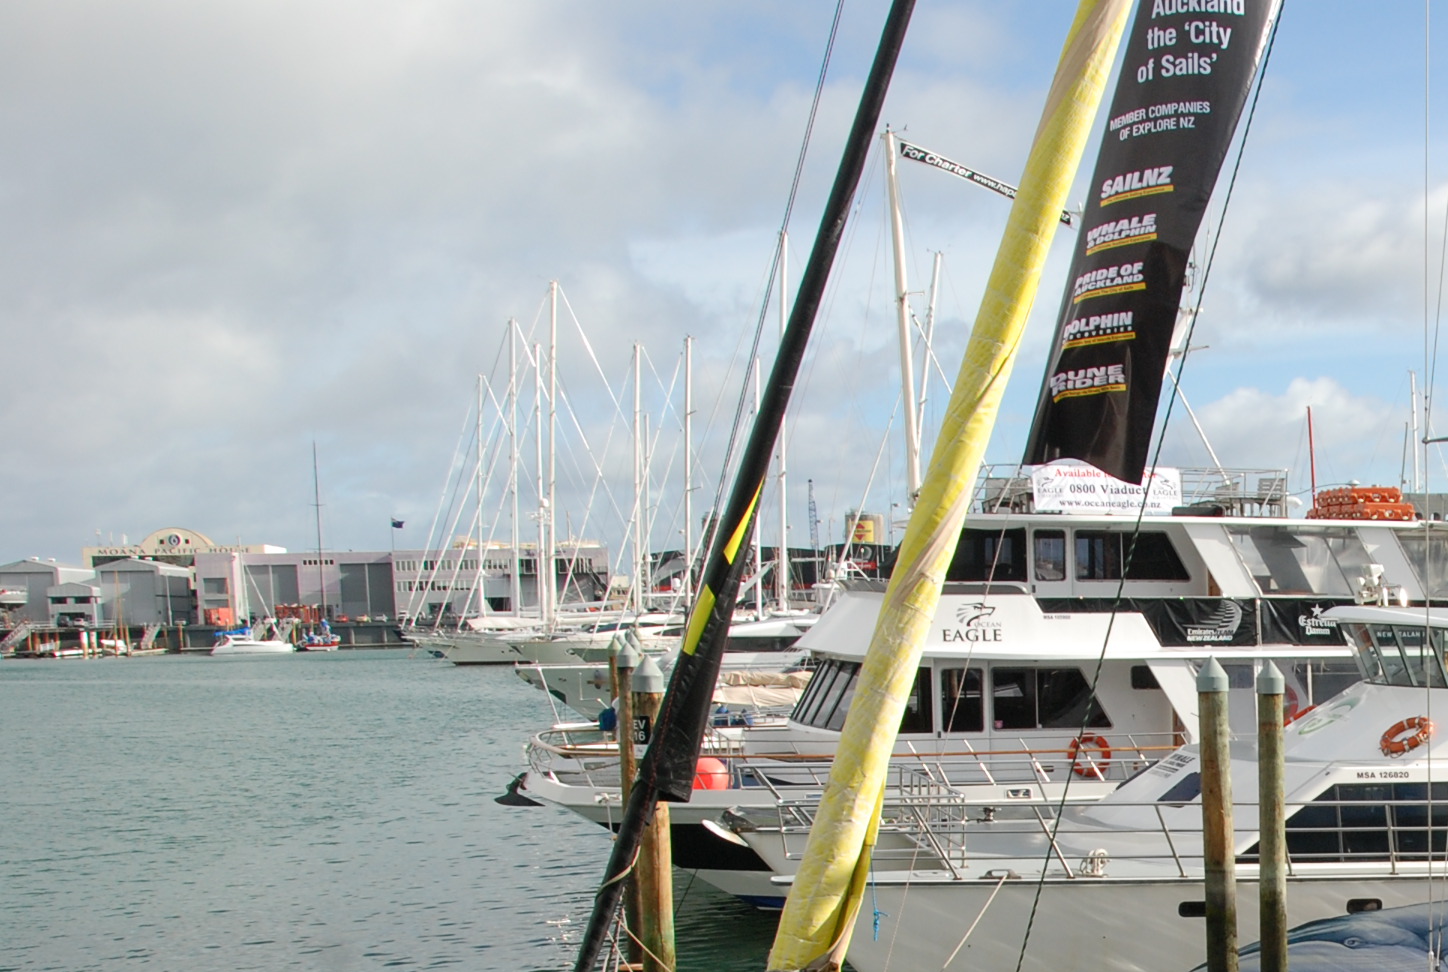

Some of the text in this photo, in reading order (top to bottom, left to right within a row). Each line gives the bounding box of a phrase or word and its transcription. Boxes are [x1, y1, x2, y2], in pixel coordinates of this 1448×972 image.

[1147, 27, 1177, 50] the
[1137, 58, 1154, 83] of
[1110, 101, 1211, 131] MEMBER COMPANIES
[1119, 116, 1196, 140] OF EXPLORE NZ
[902, 145, 925, 161] For
[925, 154, 973, 177] Charter
[1101, 166, 1173, 199] SAILNZ
[1087, 213, 1157, 241] WHALE
[1095, 225, 1157, 245] DOLPHIN
[1074, 274, 1144, 296] AUCKLAND
[1075, 262, 1144, 289] PRIDE OF
[1050, 364, 1124, 388] DUNE
[1055, 468, 1101, 478] Available
[1069, 484, 1147, 494] 0800 Viaduct
[942, 629, 1002, 642] EAGLE
[1306, 626, 1331, 635] Damm
[1379, 771, 1410, 779] 126820
